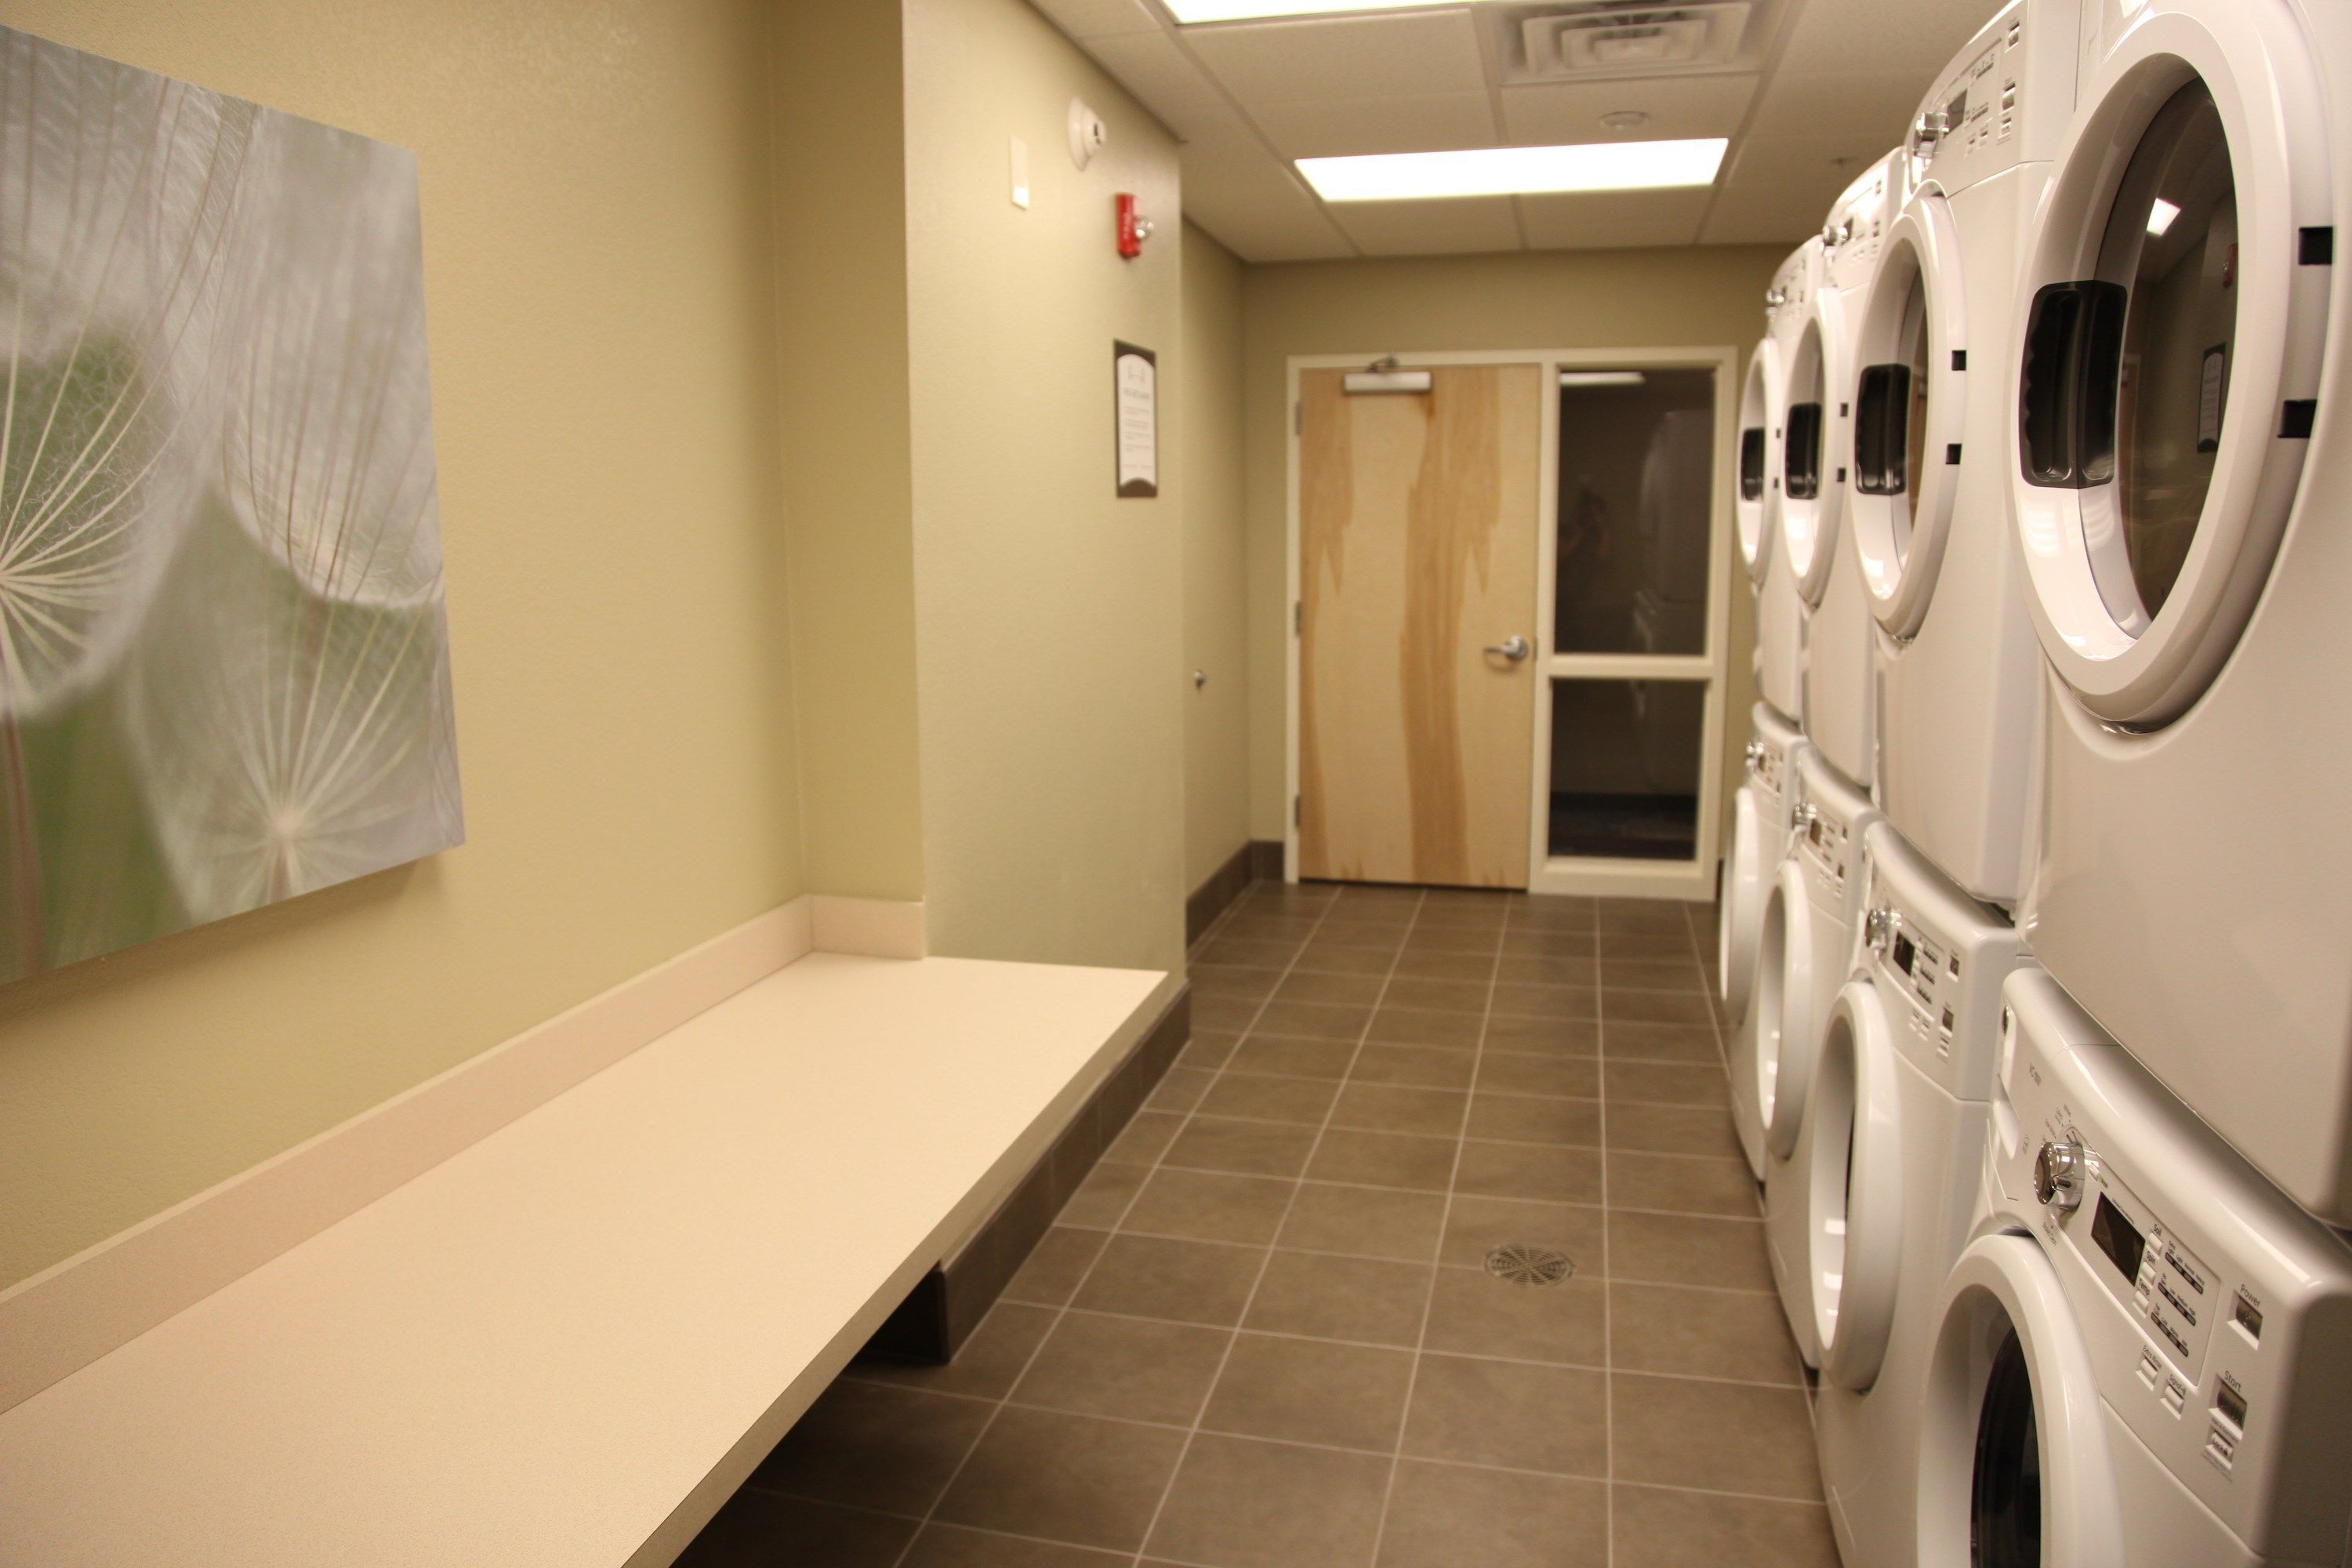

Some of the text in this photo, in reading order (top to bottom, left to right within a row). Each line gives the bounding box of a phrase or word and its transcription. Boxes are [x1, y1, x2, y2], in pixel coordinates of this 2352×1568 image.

[2153, 1224, 2162, 1236] Soil
[2146, 1250, 2155, 1265] Spin
[2139, 1277, 2150, 1296] Temp
[2241, 1283, 2260, 1307] Power
[2143, 1344, 2152, 1359] Extra
[2225, 1370, 2242, 1392] Start
